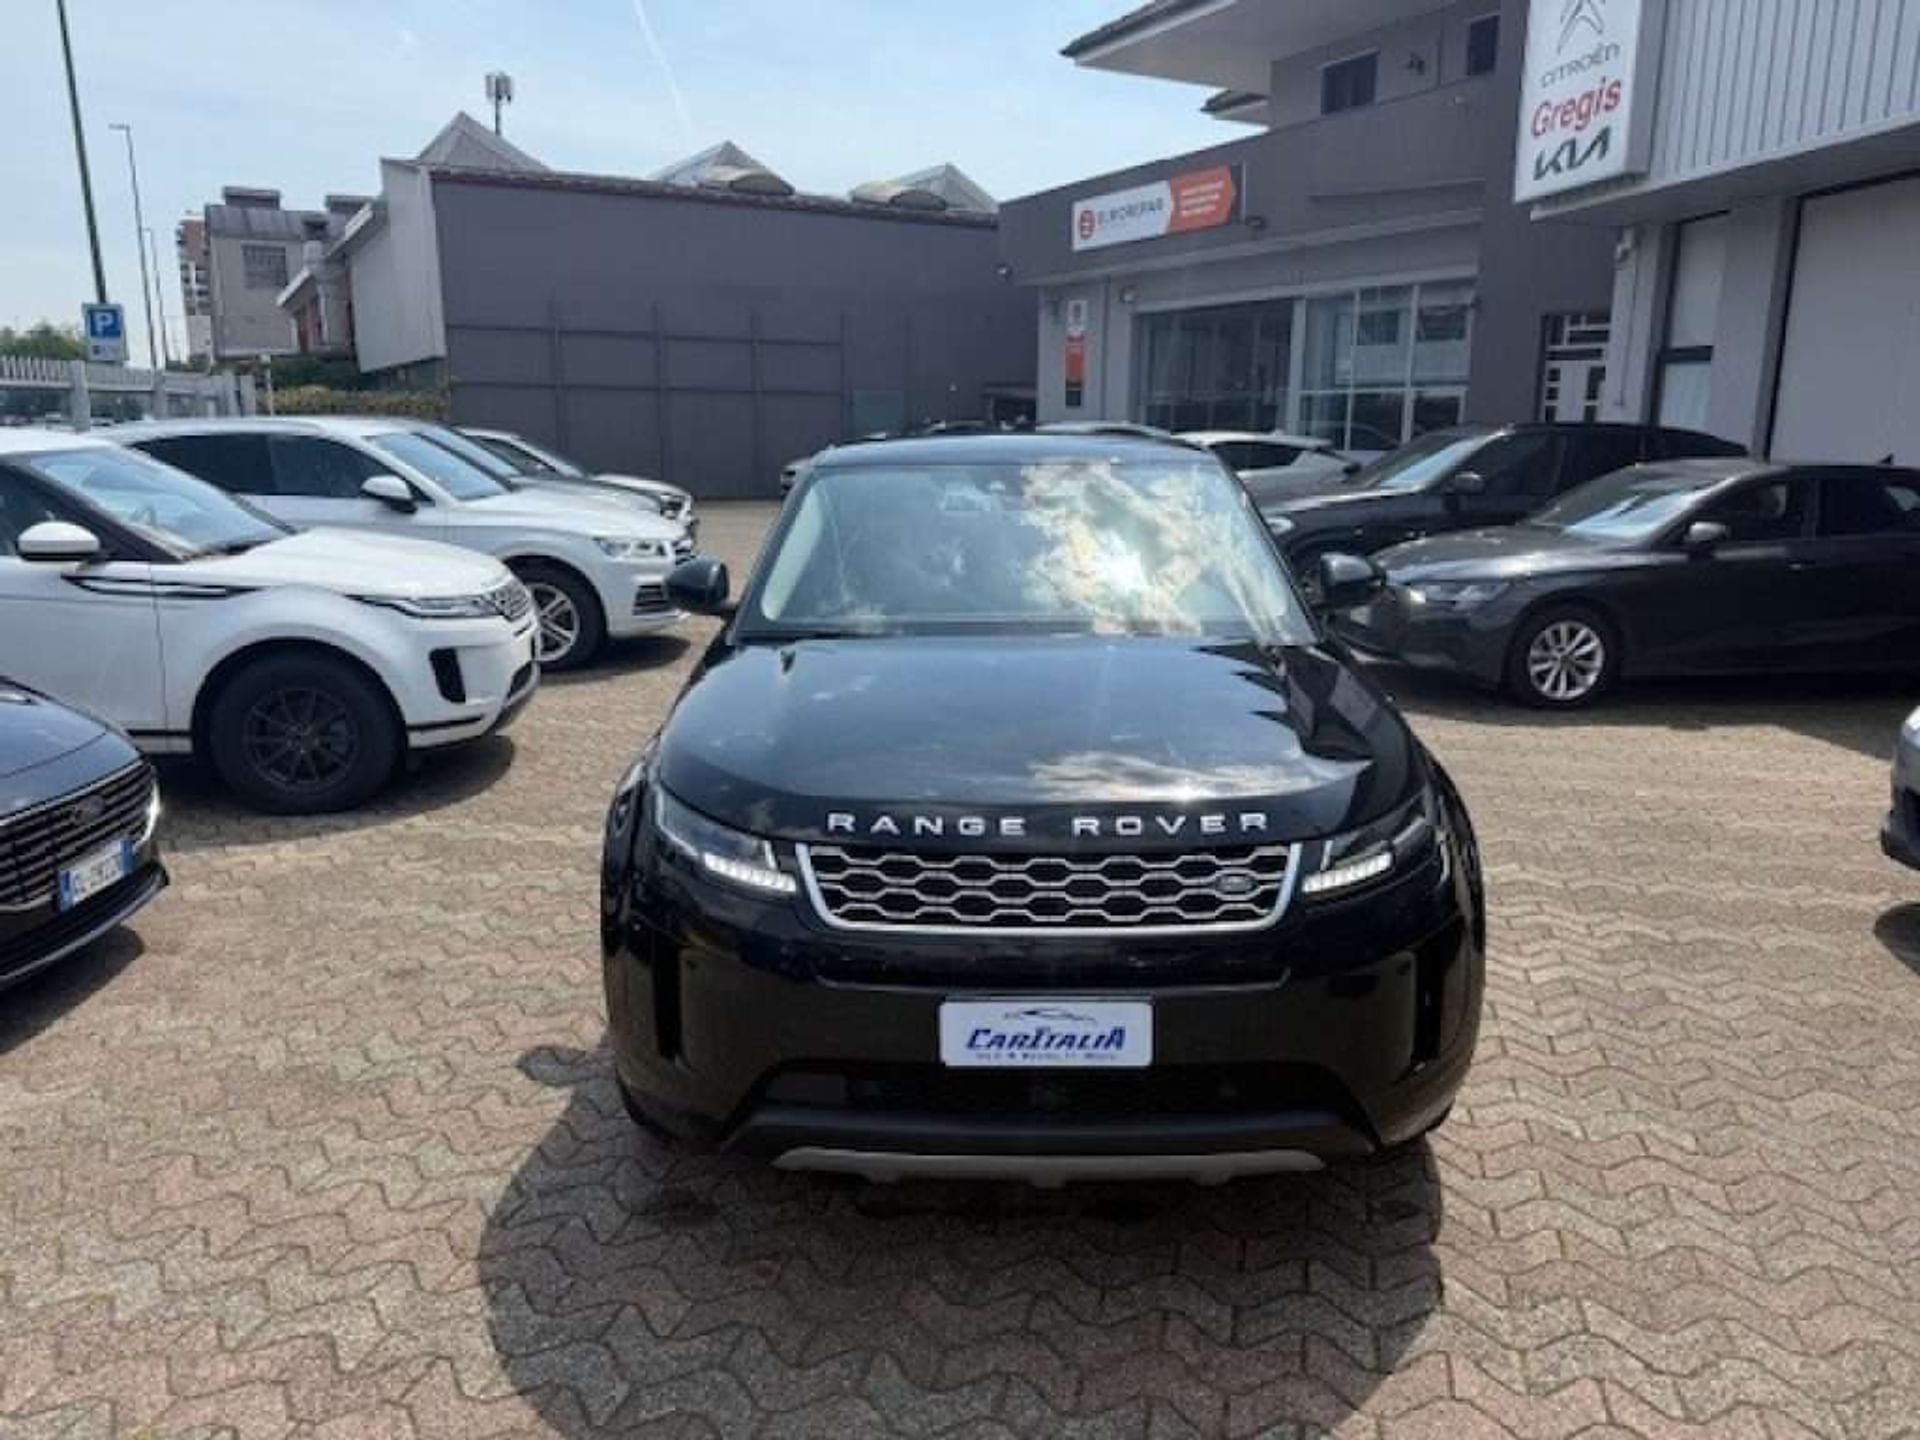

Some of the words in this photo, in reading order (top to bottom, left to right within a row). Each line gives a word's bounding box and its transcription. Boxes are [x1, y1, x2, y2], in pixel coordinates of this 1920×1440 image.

[1531, 76, 1622, 139] Gregis
[1533, 126, 1611, 181] KIA
[94, 312, 115, 335] P
[827, 812, 1026, 837] RANGE
[1072, 812, 1267, 837] ROVER
